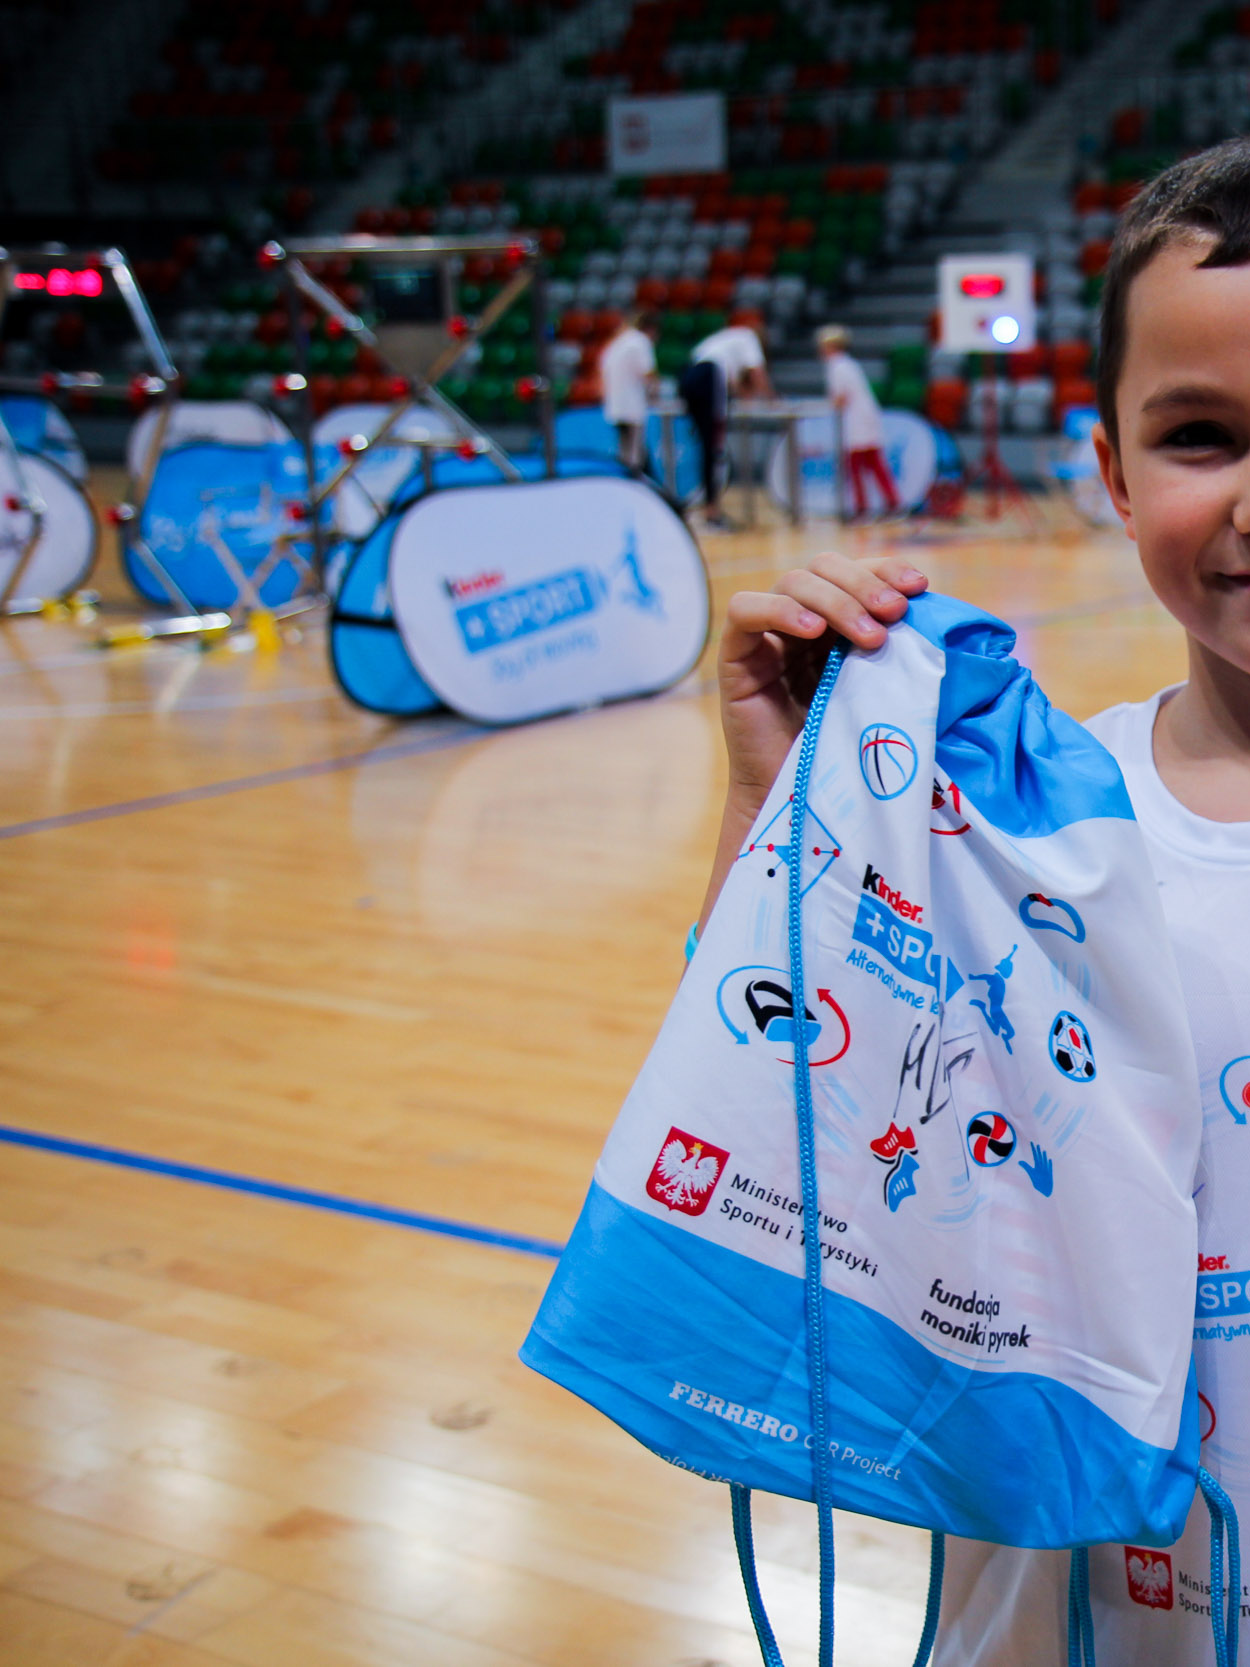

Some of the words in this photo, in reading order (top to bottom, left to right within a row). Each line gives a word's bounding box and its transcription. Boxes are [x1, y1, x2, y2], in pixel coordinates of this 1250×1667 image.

[846, 948, 925, 1009] Alternatywne
[720, 1198, 780, 1236] Sportu
[785, 1225, 794, 1240] i
[929, 1278, 1001, 1322] fundacja
[920, 1309, 987, 1346] moniki
[987, 1324, 1031, 1353] pyrek
[668, 1380, 799, 1442] FERRERO
[803, 1434, 839, 1458] CR
[840, 1446, 903, 1481] Project
